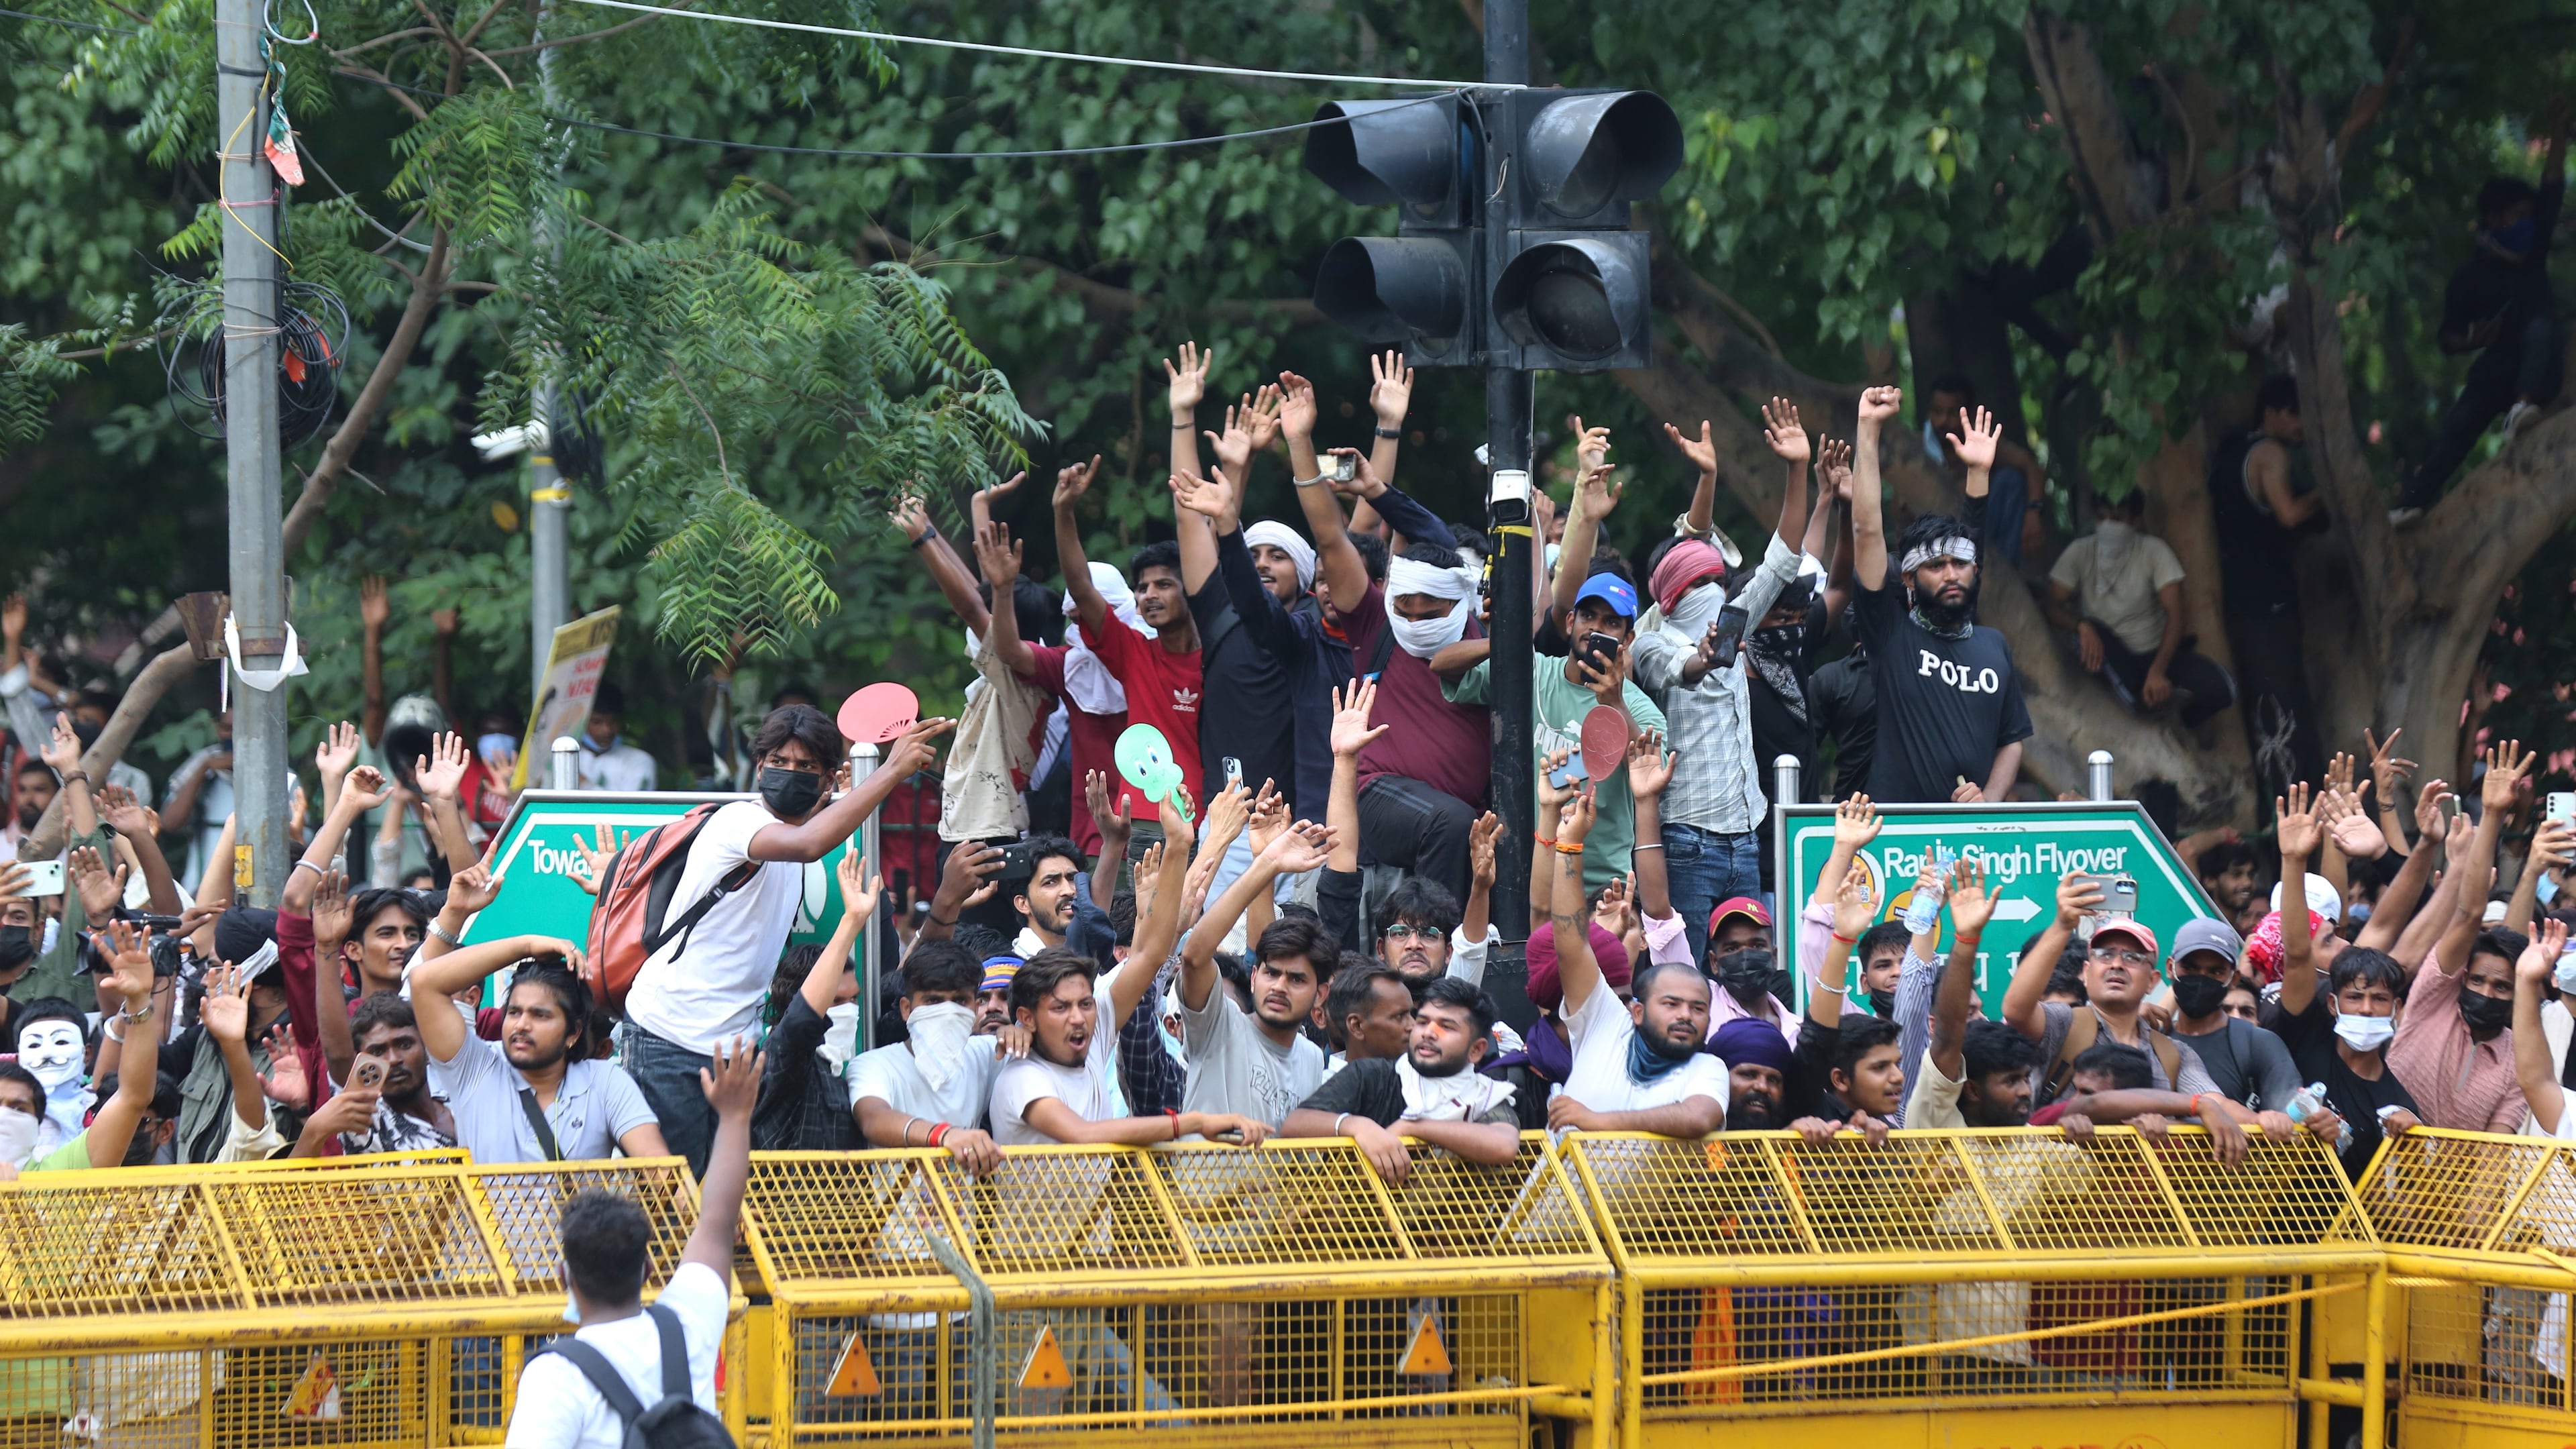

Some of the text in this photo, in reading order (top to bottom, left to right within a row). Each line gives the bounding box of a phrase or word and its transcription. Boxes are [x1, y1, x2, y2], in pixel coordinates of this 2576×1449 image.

[1919, 649, 1999, 694] POLO
[1534, 722, 1581, 755] PUM
[527, 840, 600, 875] Towa
[1884, 839, 2128, 883] Rajt Singh Flyover
